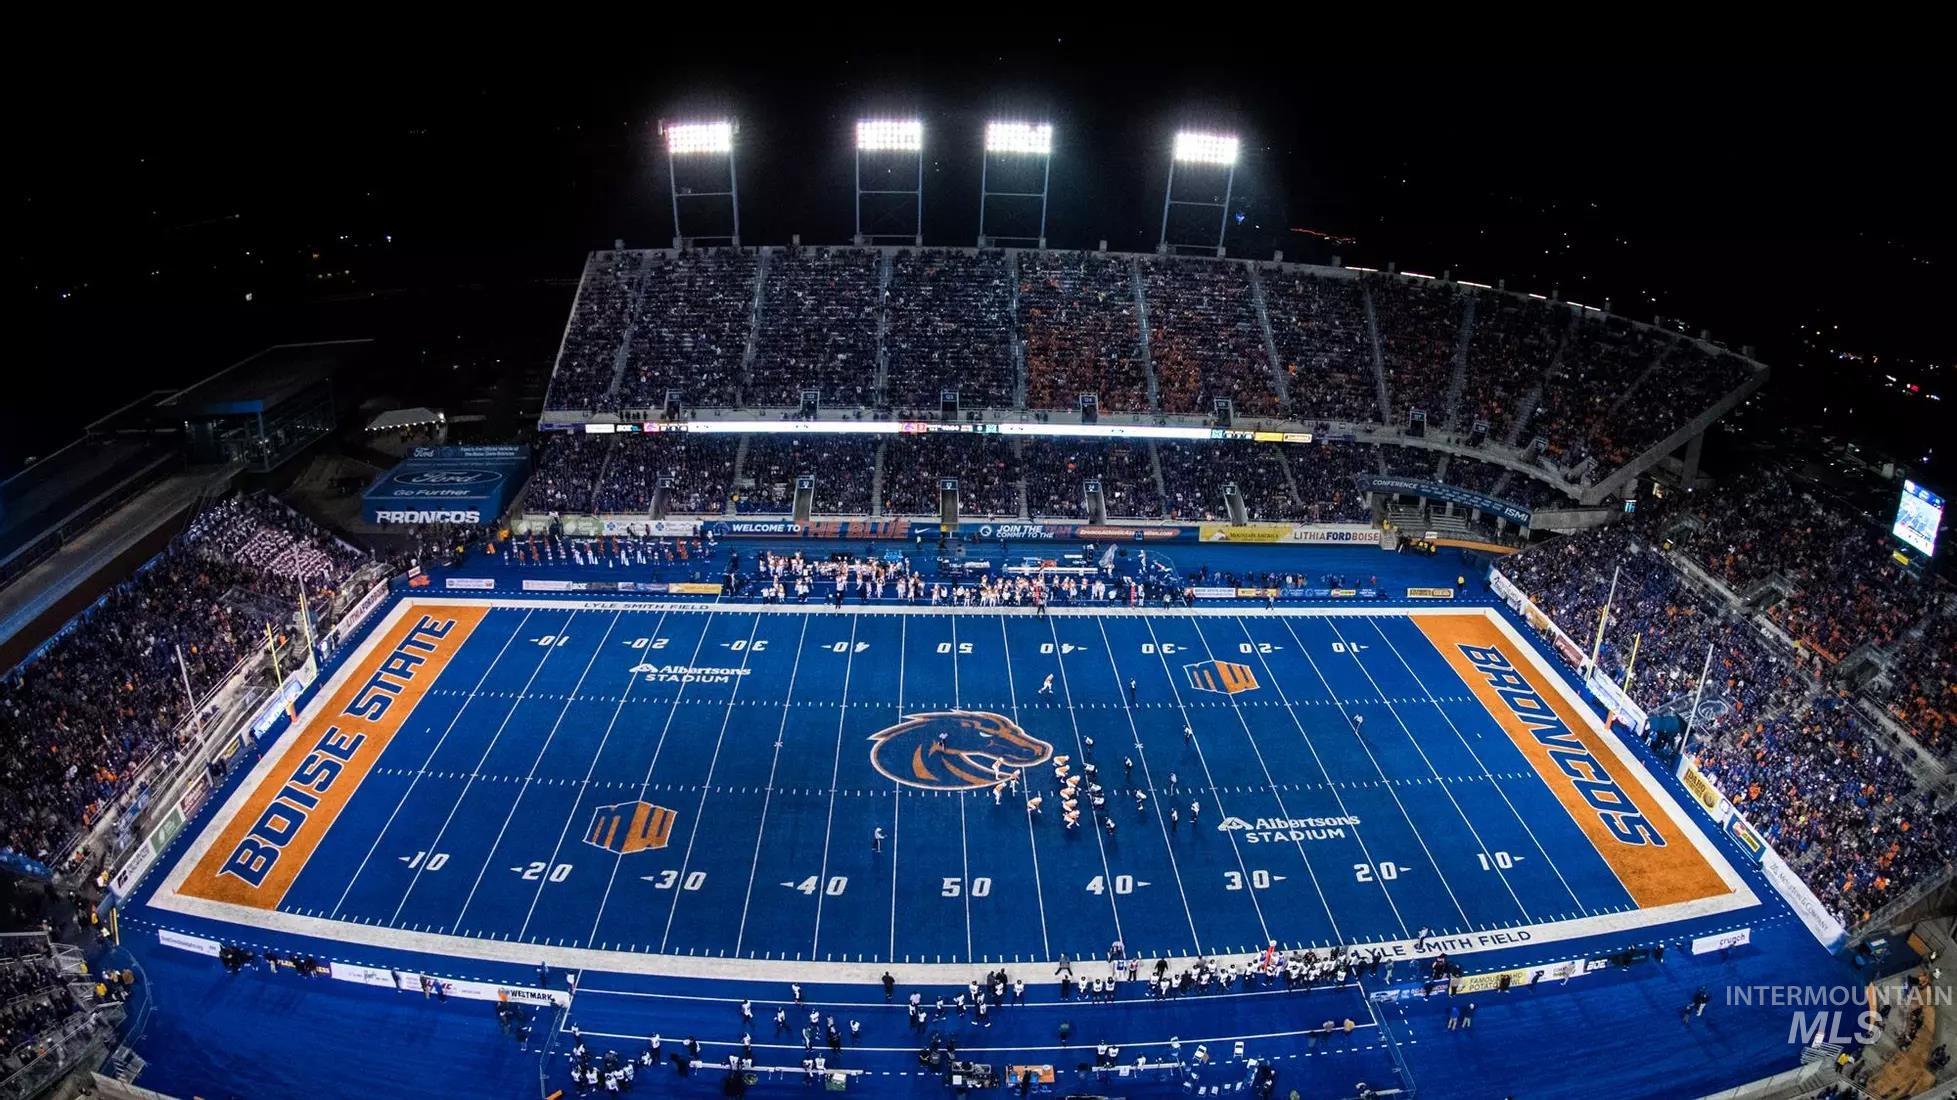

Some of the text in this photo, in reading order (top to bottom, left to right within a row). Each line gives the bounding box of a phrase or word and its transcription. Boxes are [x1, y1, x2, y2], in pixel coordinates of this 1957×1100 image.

[413, 447, 435, 458] Ford
[412, 470, 482, 484] Ford
[1372, 478, 1418, 490] CONFERENCE
[375, 510, 481, 524] BRONCOS
[732, 518, 912, 538] WELCOME TO THE BLUE
[997, 525, 1021, 533] JOIN
[1023, 525, 1043, 533] THE
[1294, 531, 1379, 541] LITHIAFORDBOISE
[537, 635, 570, 647] 10
[631, 637, 670, 649] 20
[730, 640, 769, 651] 30
[832, 641, 870, 653] 40
[936, 642, 974, 654] 50
[1040, 642, 1075, 654] 40
[1331, 642, 1361, 653] 10
[1141, 643, 1176, 654] 30
[1239, 643, 1274, 654] 20
[659, 664, 751, 676] Albertsons
[645, 673, 729, 683] STADIUM
[216, 615, 458, 888] BOISE STATE
[1456, 643, 1667, 847] BRONCOS
[1686, 767, 1706, 794] IDAHO
[1256, 815, 1360, 830] Albertsons
[1246, 828, 1345, 844] STADIUM
[409, 851, 451, 871] 10
[1476, 851, 1513, 871] 10
[522, 861, 573, 883] 20
[1353, 862, 1399, 883] 20
[654, 871, 707, 891] 30
[795, 876, 848, 896] 40
[941, 877, 992, 897] 50
[1086, 875, 1134, 895] 40
[1224, 870, 1270, 890] 30
[1414, 936, 1473, 955] SMITH
[1478, 931, 1532, 946] FIELD
[1719, 933, 1746, 946] crunch
